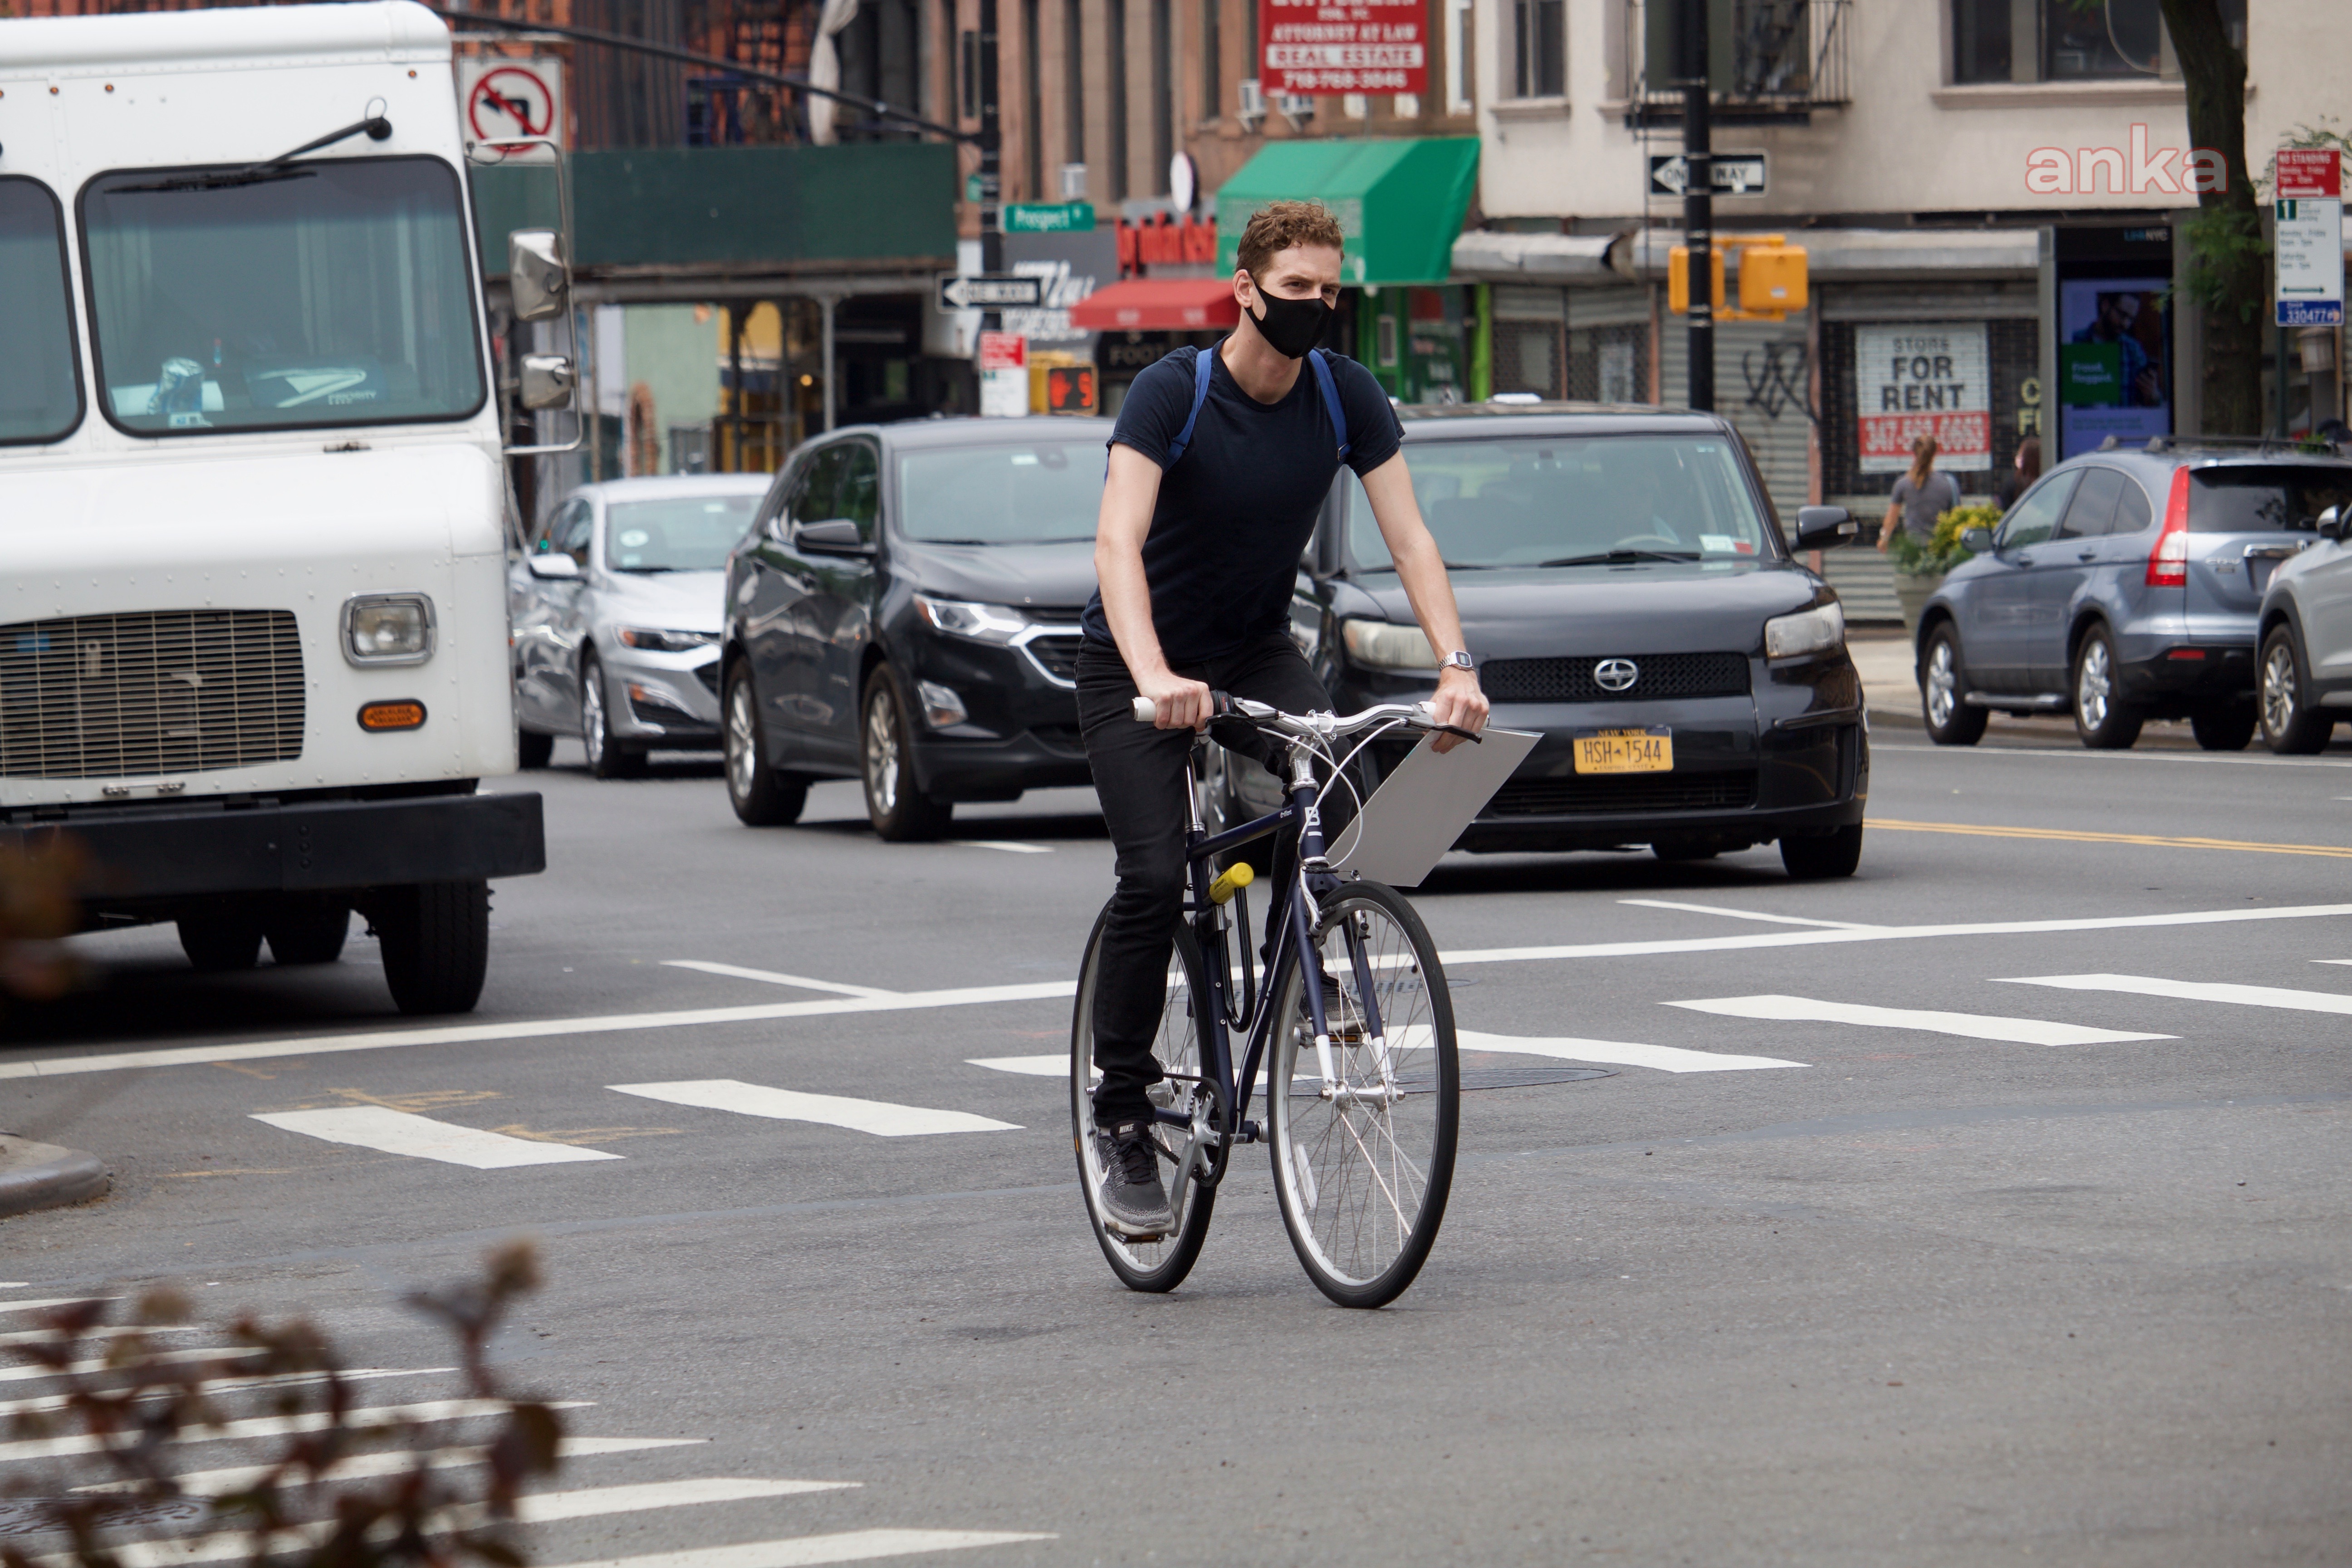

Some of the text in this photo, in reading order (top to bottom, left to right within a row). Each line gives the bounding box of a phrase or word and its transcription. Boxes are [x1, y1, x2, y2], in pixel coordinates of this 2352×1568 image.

[1272, 23, 1417, 42] ATTORNEY AT LAW
[1276, 49, 1413, 63] REAL ESTATE
[2293, 153, 2331, 164] STANDING
[1715, 168, 1749, 180] WAY
[2282, 201, 2289, 219] 1
[1014, 206, 1070, 232] Prospect
[2287, 309, 2327, 323] 330477
[1893, 338, 1949, 353] STORE
[1891, 356, 1952, 380] FOR
[1882, 384, 1964, 410] RENT
[1583, 740, 1661, 763] HSH 1544
[1119, 1123, 1134, 1134] NIKE
